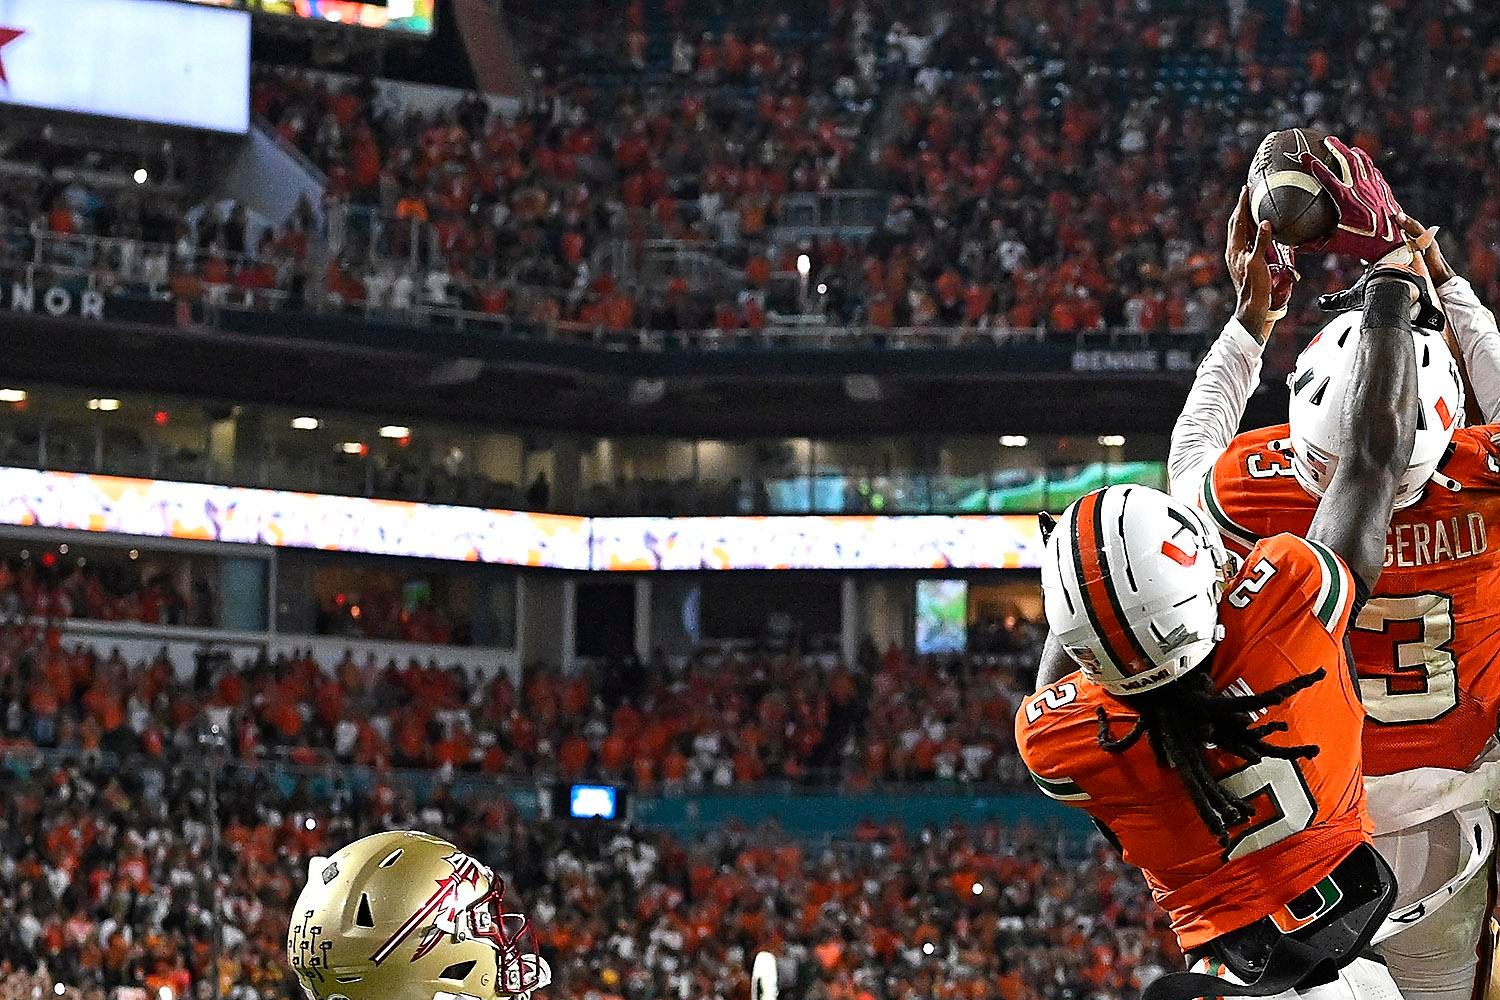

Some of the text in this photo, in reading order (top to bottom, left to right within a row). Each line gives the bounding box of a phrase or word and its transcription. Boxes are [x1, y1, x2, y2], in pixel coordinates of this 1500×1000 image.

[0, 283, 104, 320] NOR
[1382, 511, 1489, 568] GERALD
[1228, 556, 1278, 609] 2
[1120, 668, 1171, 691] MIAMI
[1355, 593, 1458, 724] 3
[1024, 680, 1078, 725] 2
[1217, 756, 1317, 861] 2
